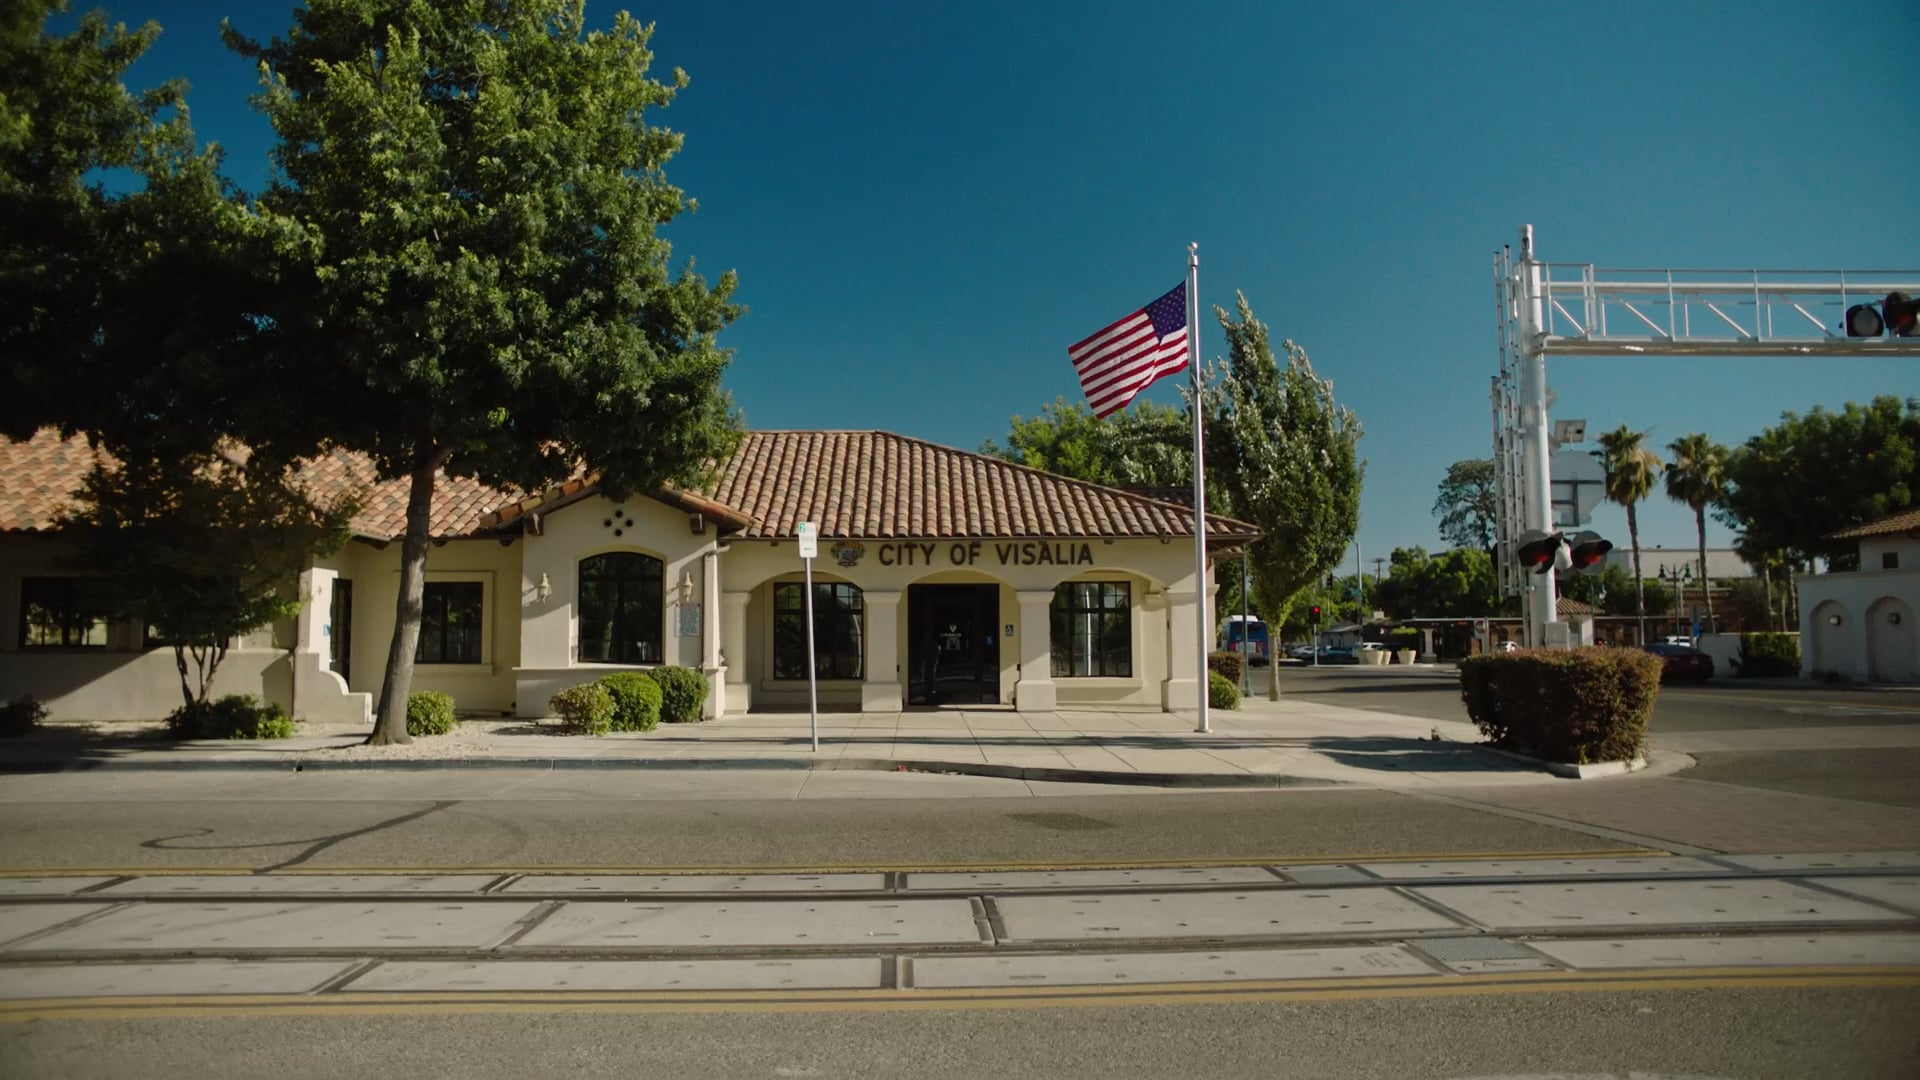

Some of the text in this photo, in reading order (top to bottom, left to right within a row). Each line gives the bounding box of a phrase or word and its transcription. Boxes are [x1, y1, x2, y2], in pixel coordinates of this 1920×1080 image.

[878, 542, 1094, 566] CITY OF VISALIA
